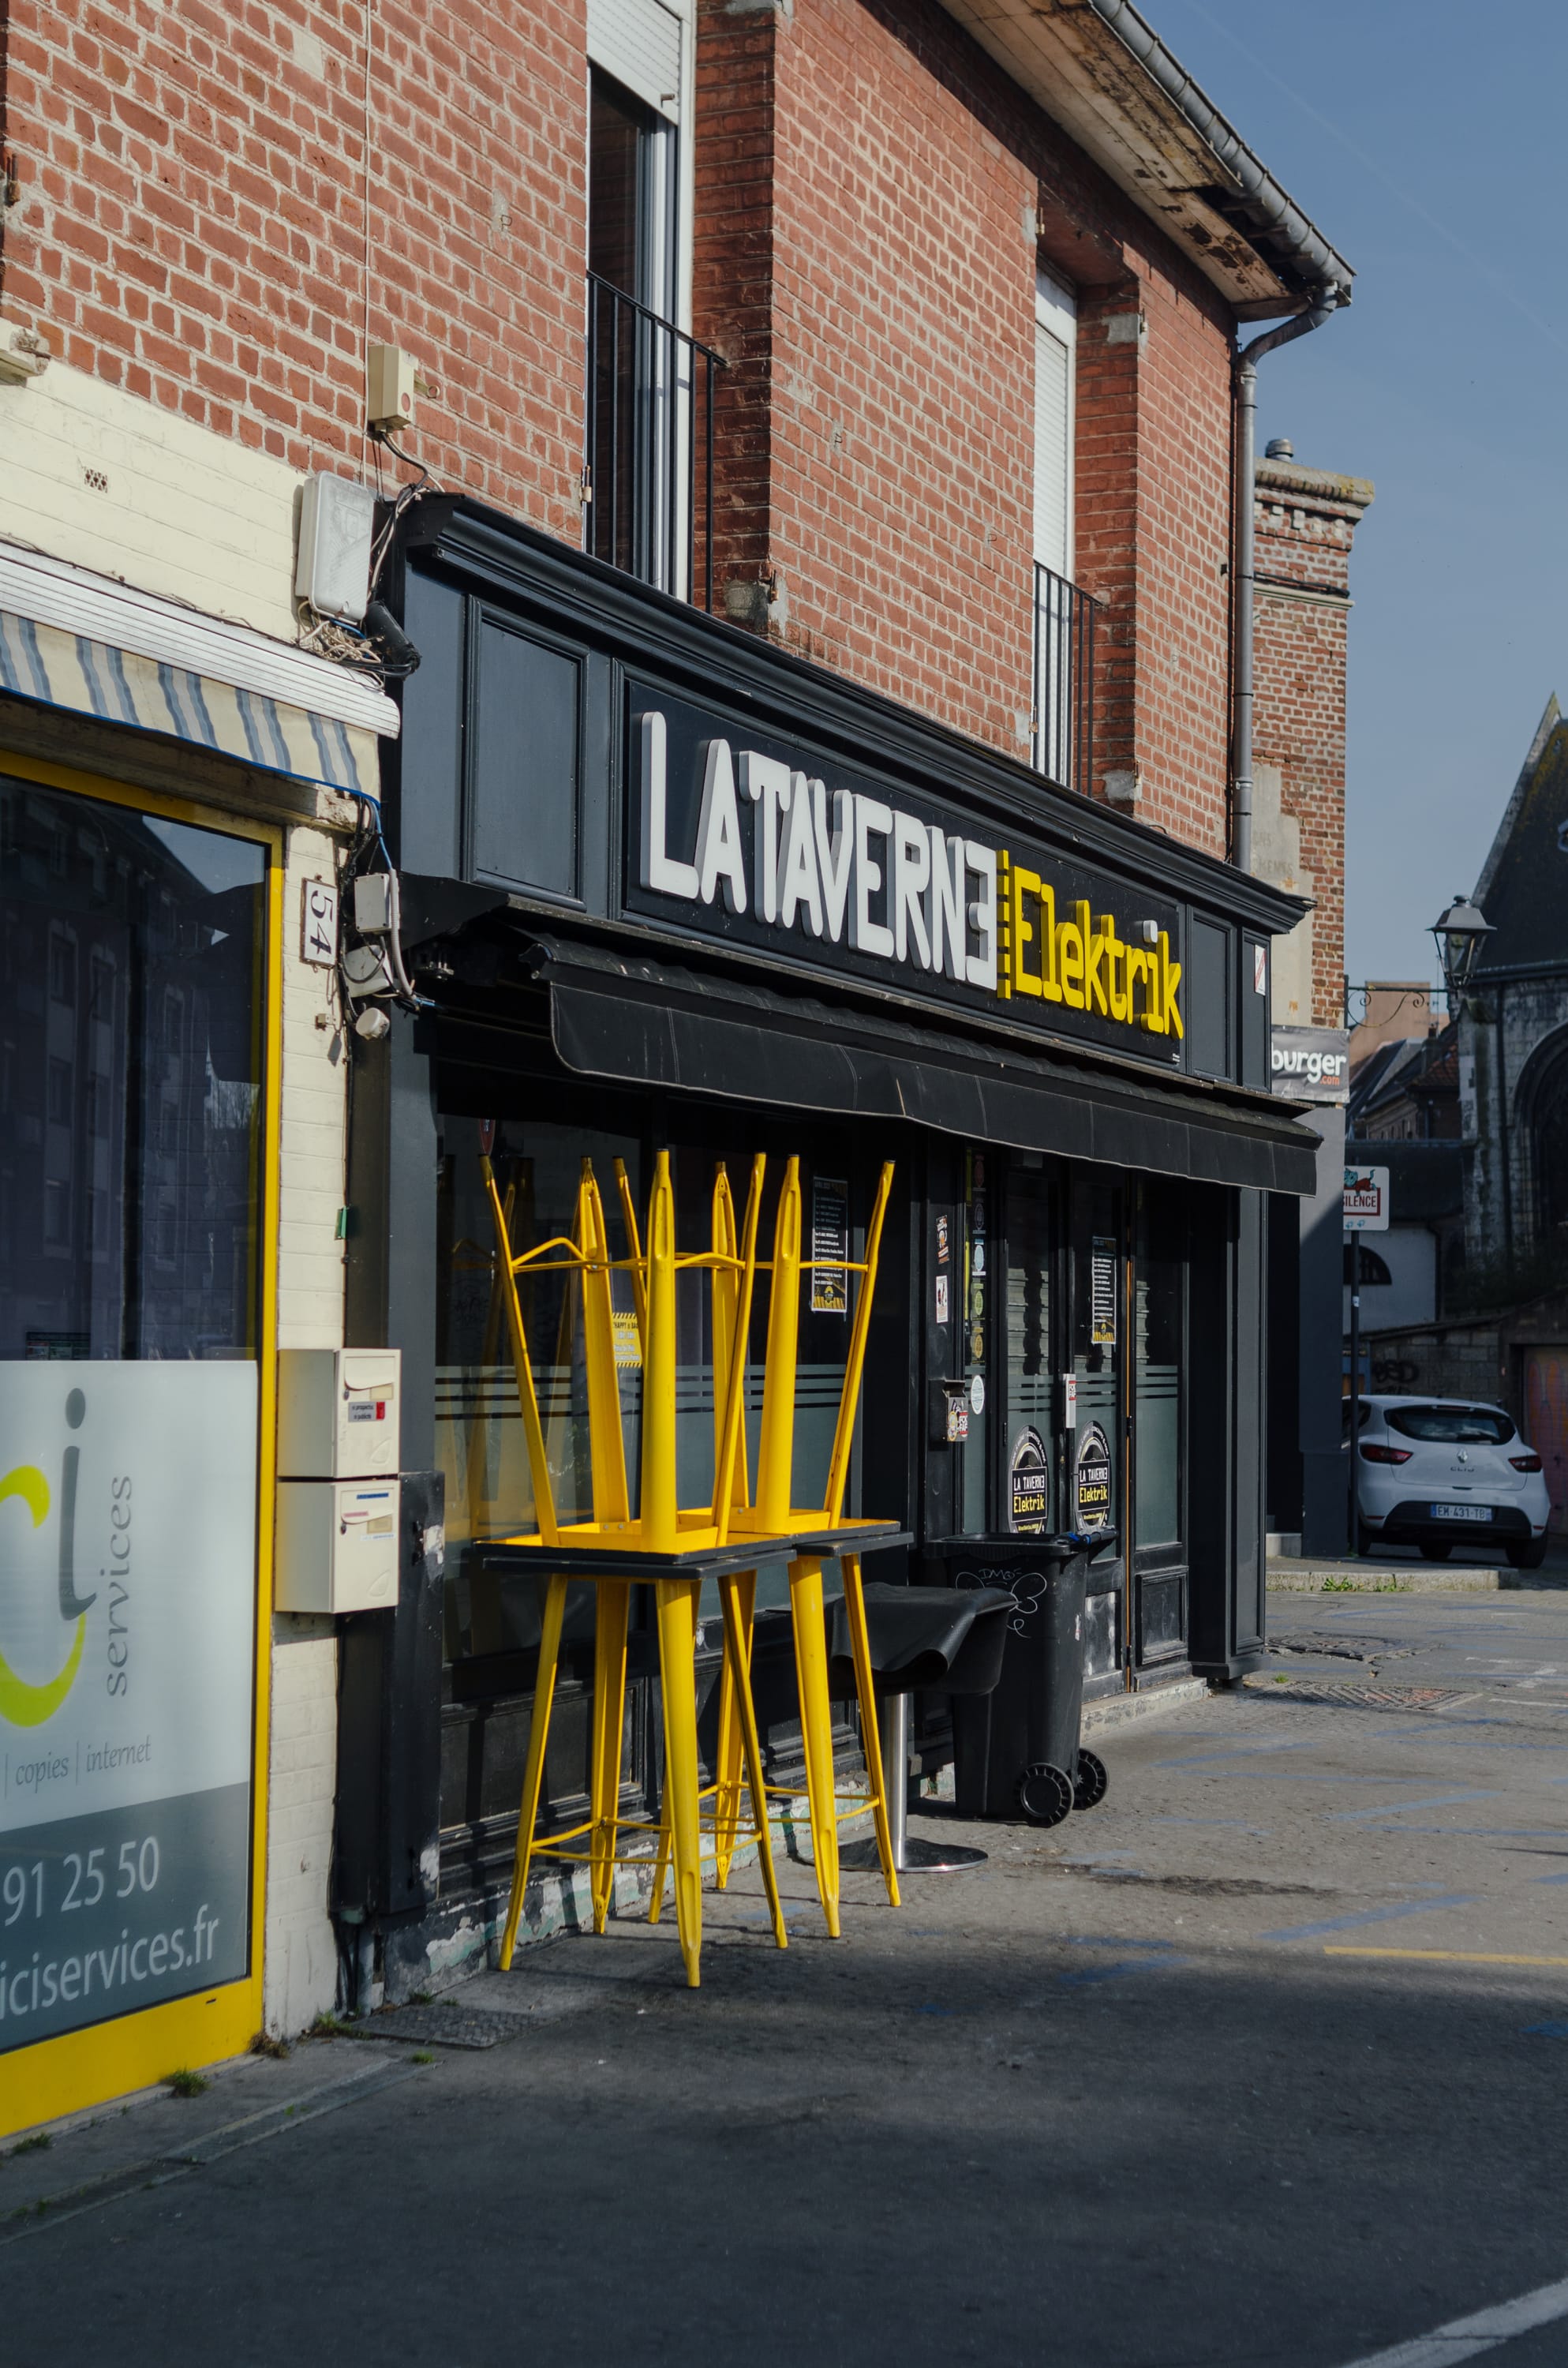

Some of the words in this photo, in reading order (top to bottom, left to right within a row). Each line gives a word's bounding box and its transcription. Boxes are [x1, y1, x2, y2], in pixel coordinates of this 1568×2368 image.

[309, 890, 333, 955] 54
[1012, 864, 1184, 1040] Elektrik
[1271, 1041, 1347, 1085] burger
[1343, 1194, 1377, 1208] ILENCE
[1013, 1477, 1021, 1492] LA
[1079, 1469, 1087, 1483] LA
[1079, 1484, 1108, 1504] Elektrik
[1013, 1493, 1045, 1514] Elektrik
[100, 1474, 133, 1698] services
[15, 1751, 70, 1794] copies
[85, 1734, 153, 1774] internet
[3, 1860, 45, 1928] 91
[60, 1847, 107, 1913] 25
[116, 1834, 160, 1899] 50
